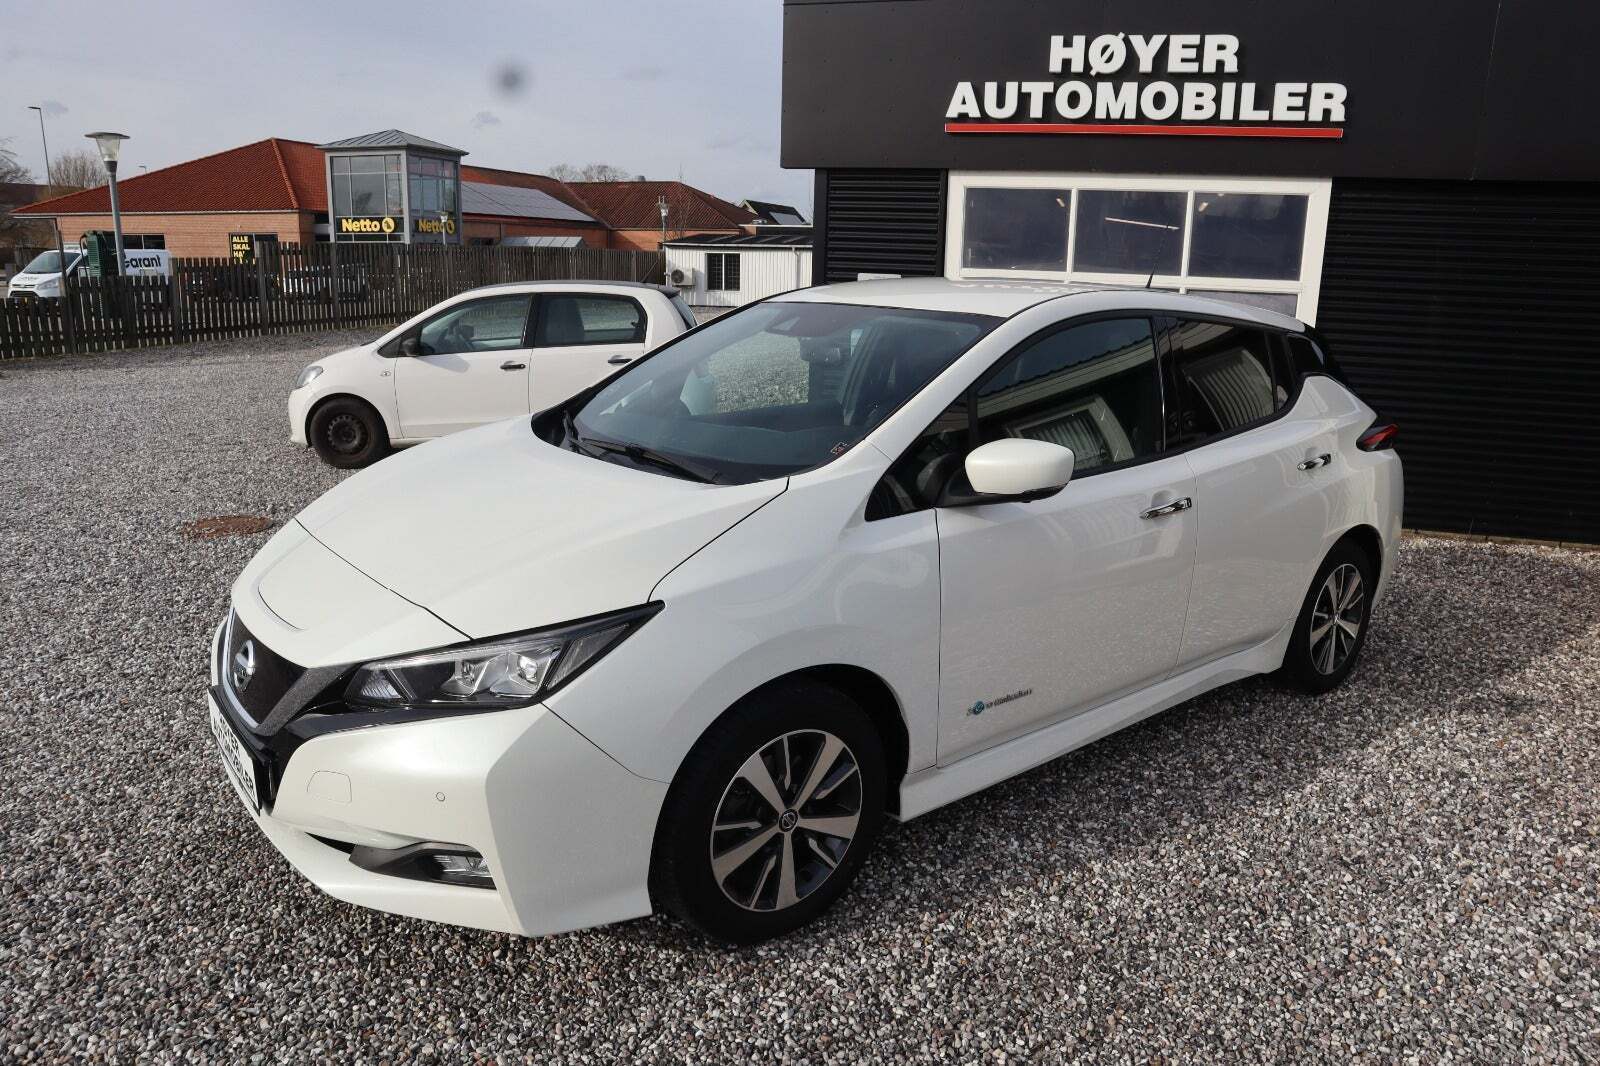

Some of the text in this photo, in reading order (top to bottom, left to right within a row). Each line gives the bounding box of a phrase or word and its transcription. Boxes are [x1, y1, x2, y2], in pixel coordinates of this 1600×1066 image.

[1048, 32, 1241, 77] HØYER
[945, 80, 1349, 122] AUTOMOBILER
[341, 218, 380, 232] Netto
[232, 235, 249, 243] ALLE
[232, 243, 251, 251] SKAL
